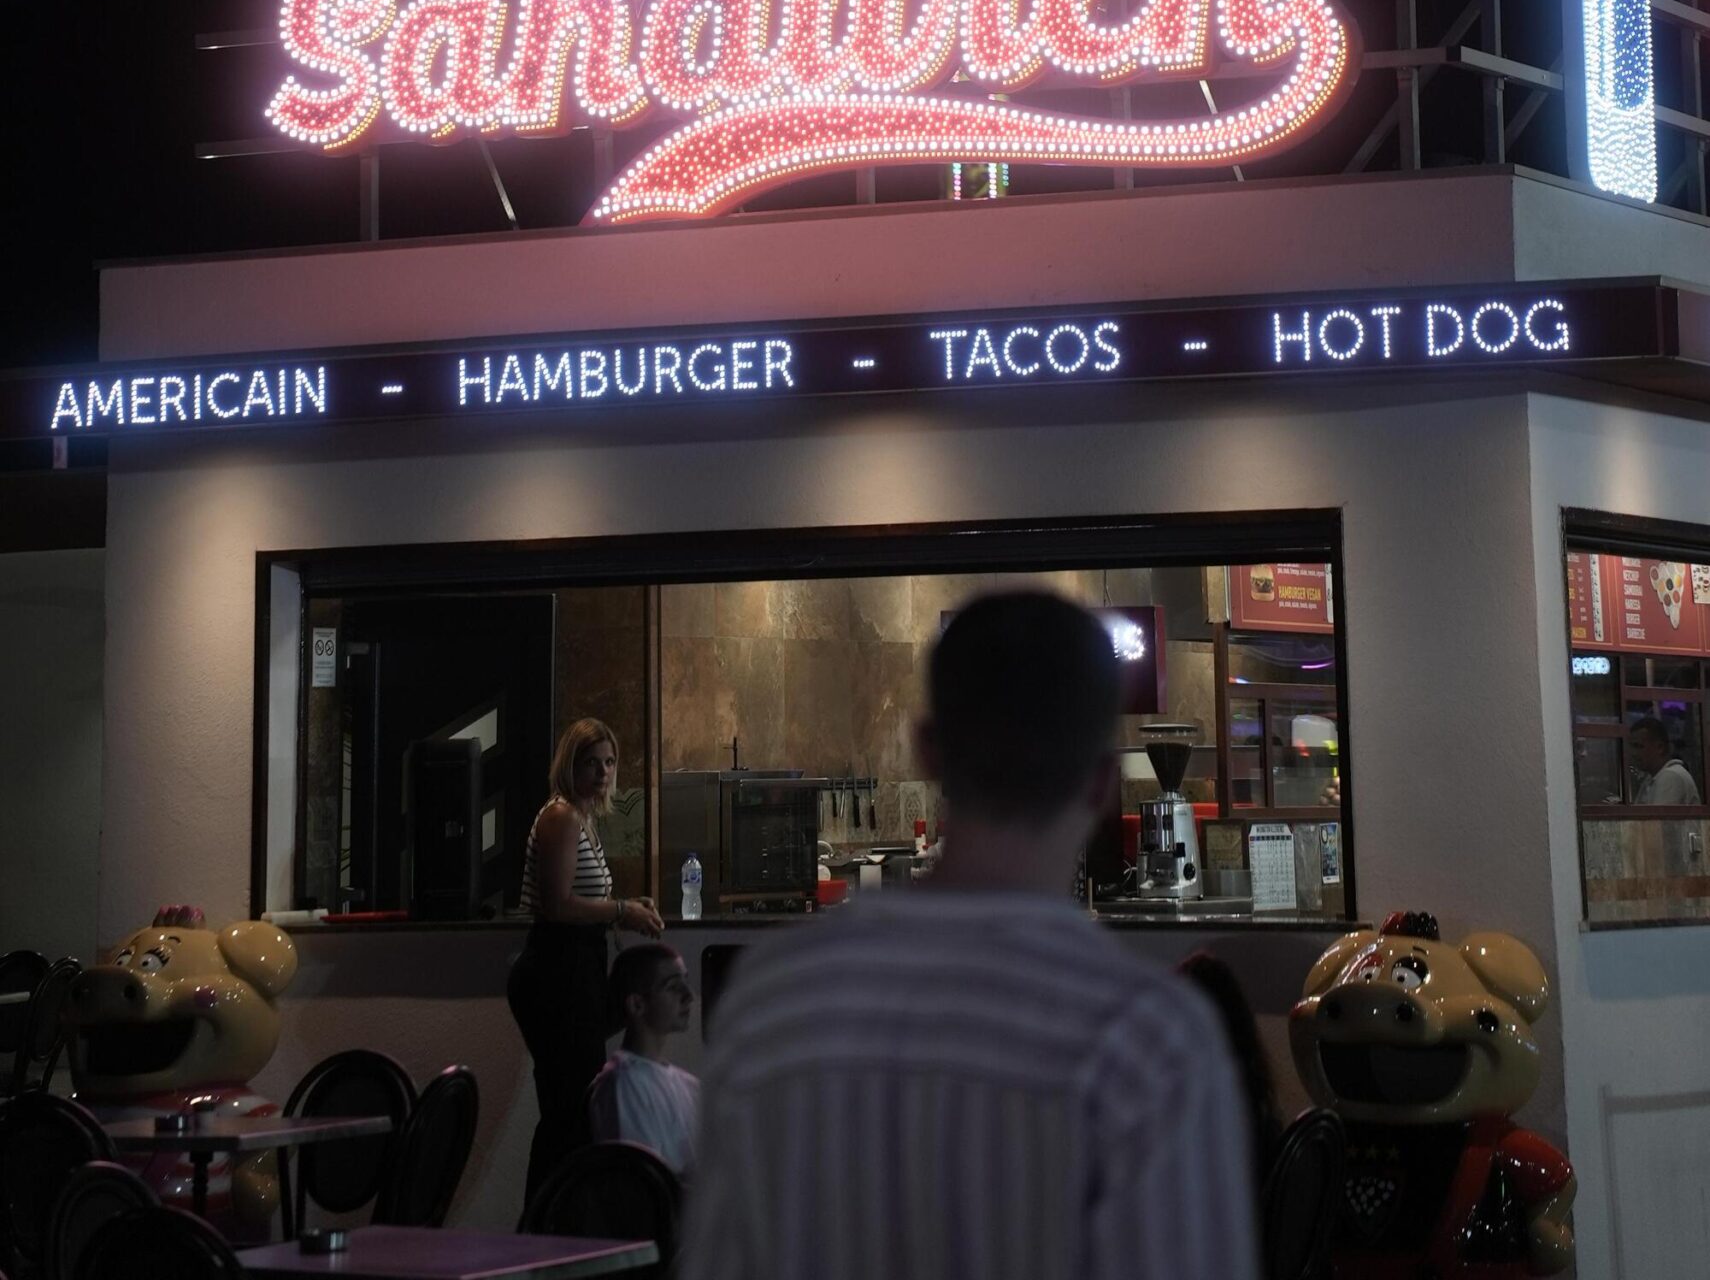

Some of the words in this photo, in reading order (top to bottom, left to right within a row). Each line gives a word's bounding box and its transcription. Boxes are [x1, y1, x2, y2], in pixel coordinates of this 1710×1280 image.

[50, 366, 326, 429] AMERICAIN
[458, 339, 794, 406] HAMBURGER
[929, 321, 1121, 380] TACOS
[1273, 306, 1401, 363] HOT
[1426, 299, 1570, 357] DOG
